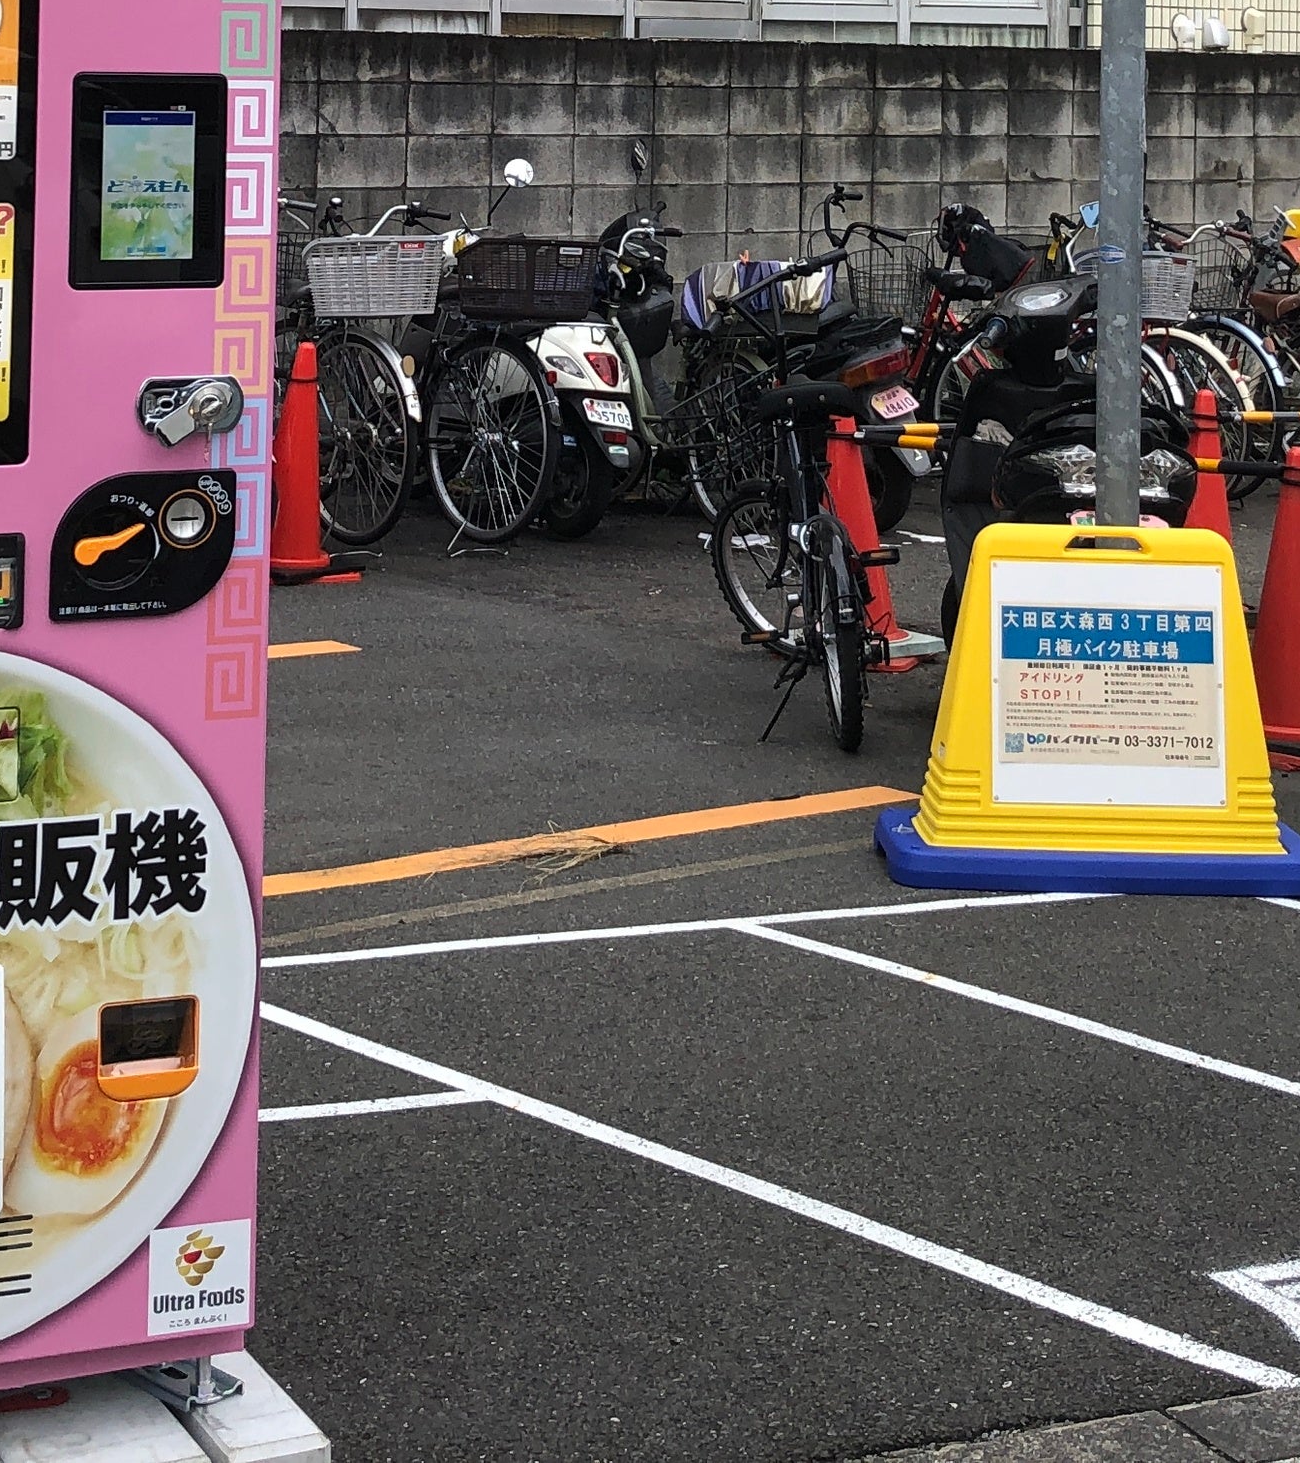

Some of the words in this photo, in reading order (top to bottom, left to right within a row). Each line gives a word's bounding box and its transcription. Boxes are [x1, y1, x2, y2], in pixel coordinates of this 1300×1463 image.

[1037, 638, 1179, 660] 月極バイク駐車場
[1019, 672, 1084, 684] アイドリング
[1125, 735, 1214, 749] 03-3371-7012
[154, 1294, 195, 1314] Ultra
[199, 1286, 245, 1308] Foods
